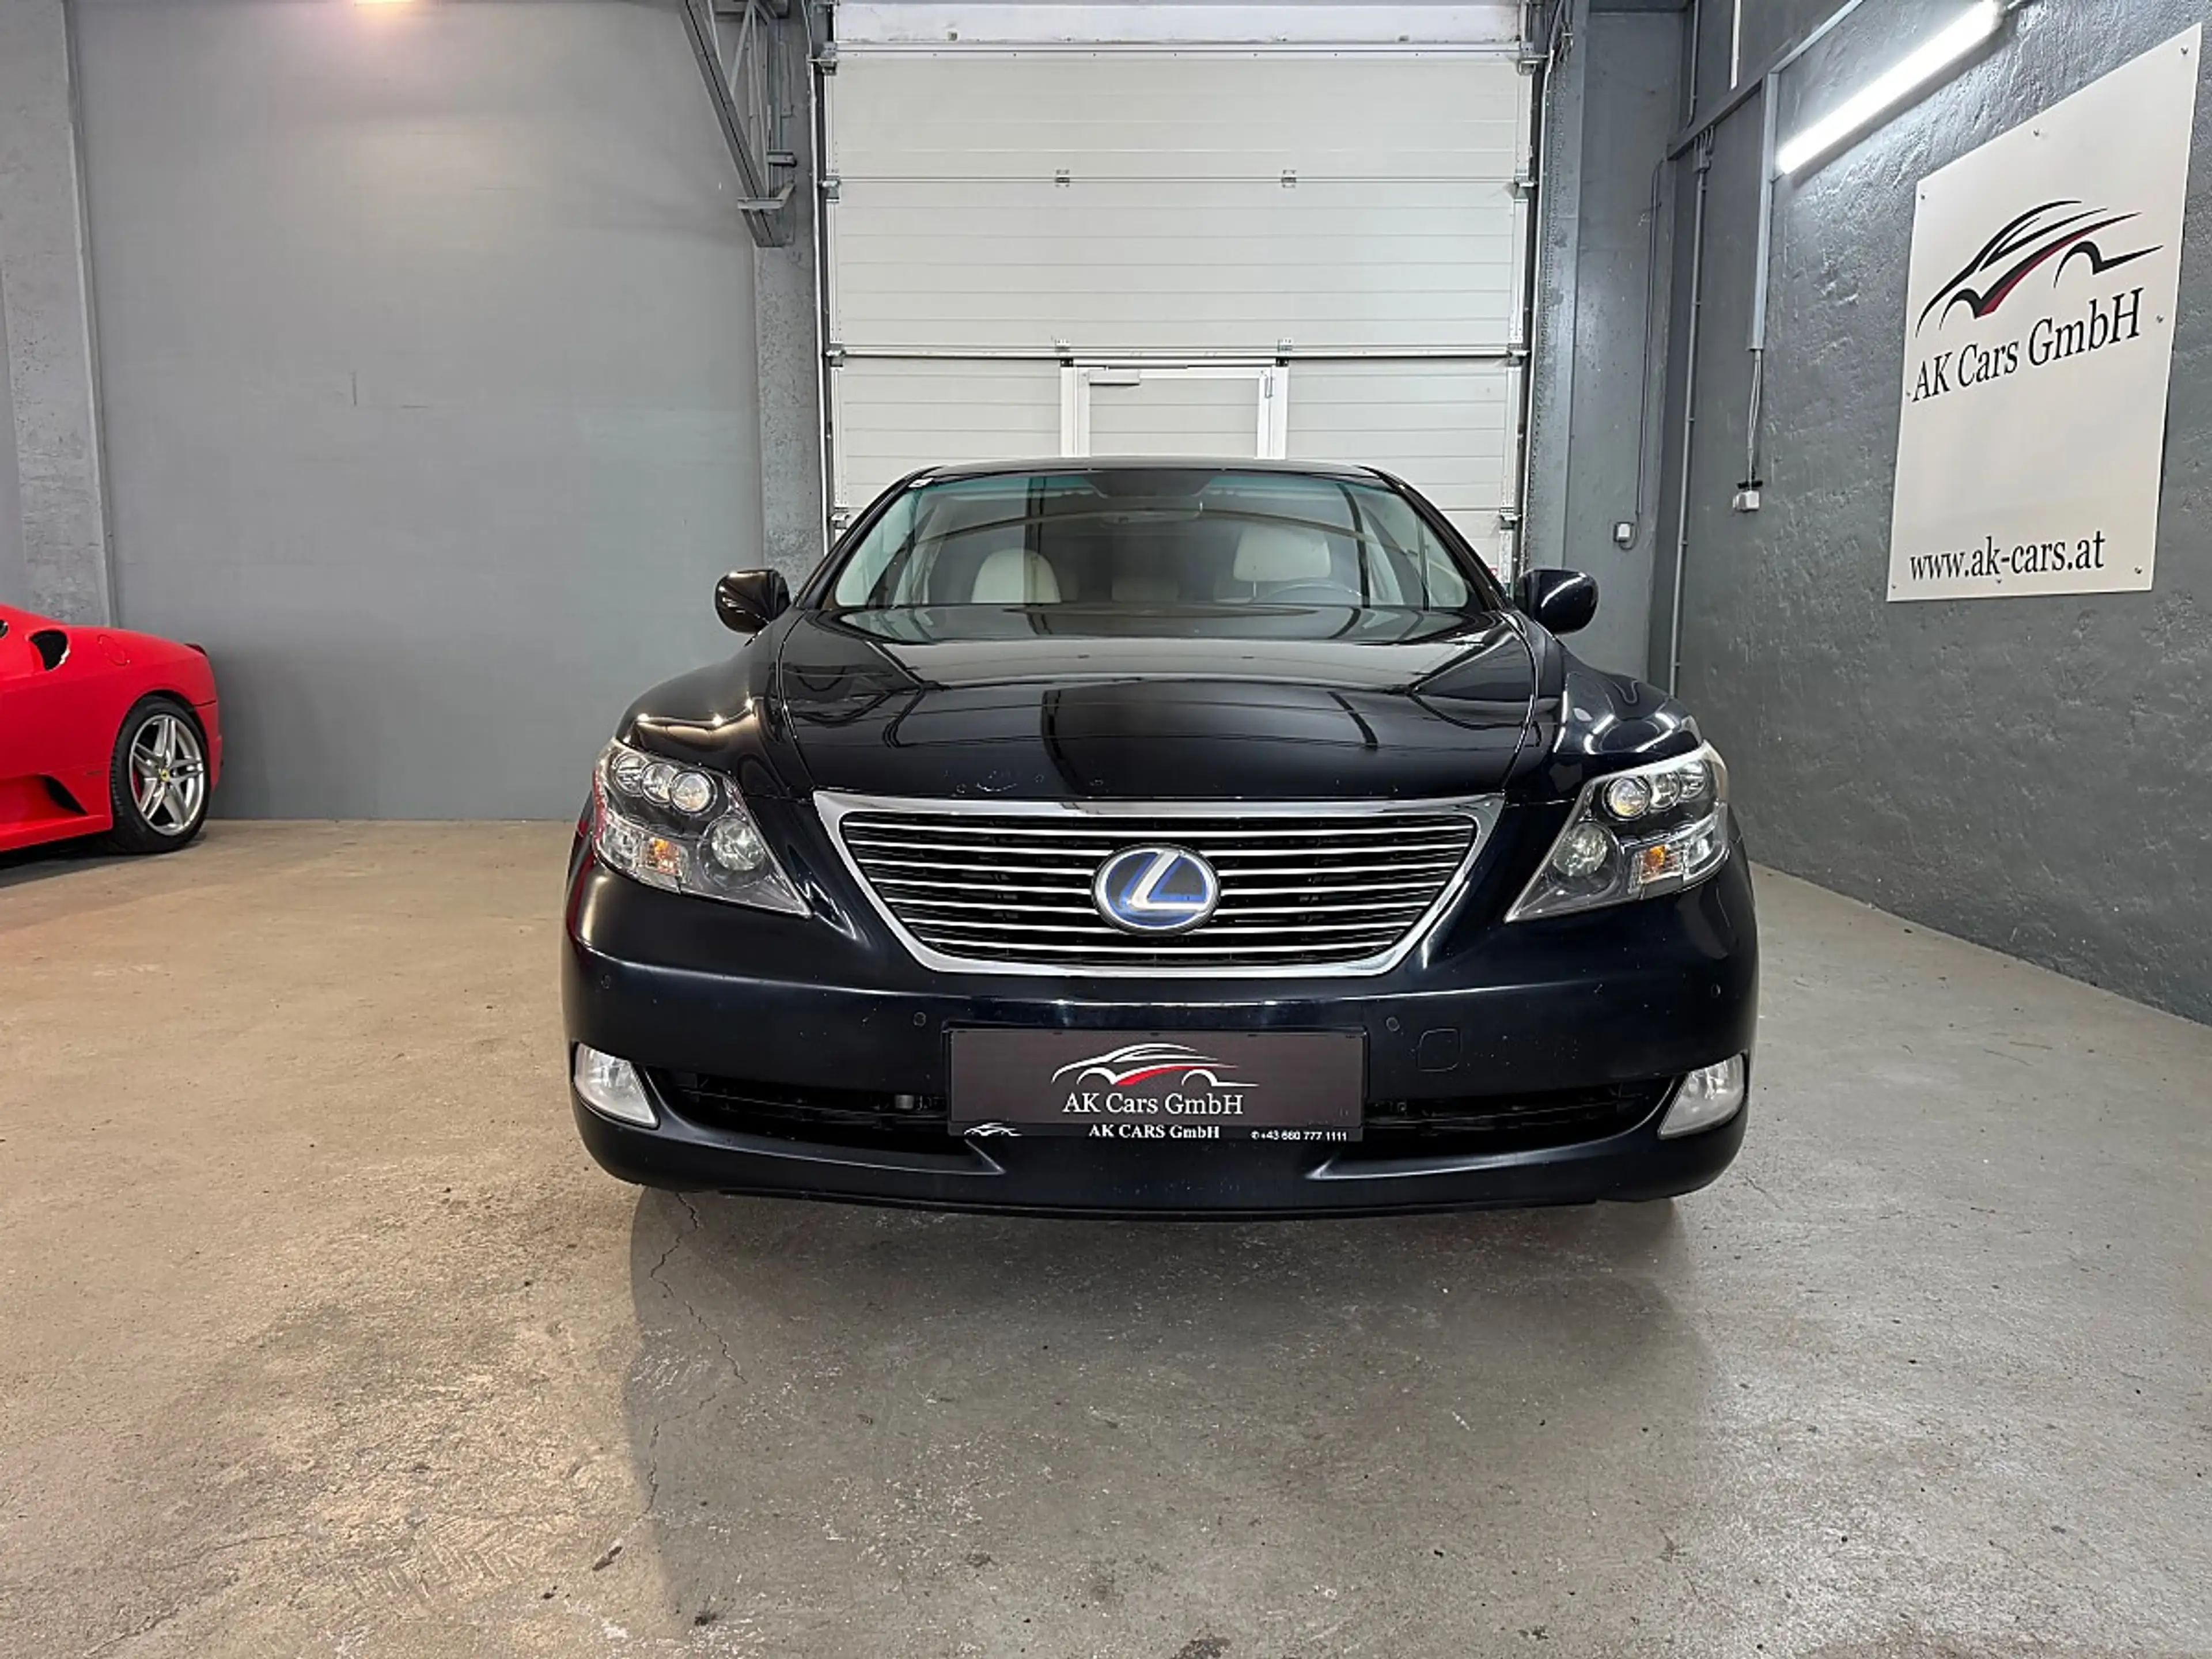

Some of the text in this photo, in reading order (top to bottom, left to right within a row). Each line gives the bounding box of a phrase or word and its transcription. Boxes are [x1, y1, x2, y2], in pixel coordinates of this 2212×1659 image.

[1912, 287, 2144, 403] AK Cars GmbH
[1910, 531, 2105, 581] www.ak-cars.at
[1062, 1092, 1243, 1115] AK Cars GmbH
[1089, 1124, 1219, 1138] AK CARS GmbH
[1304, 1131, 1323, 1141] 777
[1326, 1131, 1347, 1141] 1111
